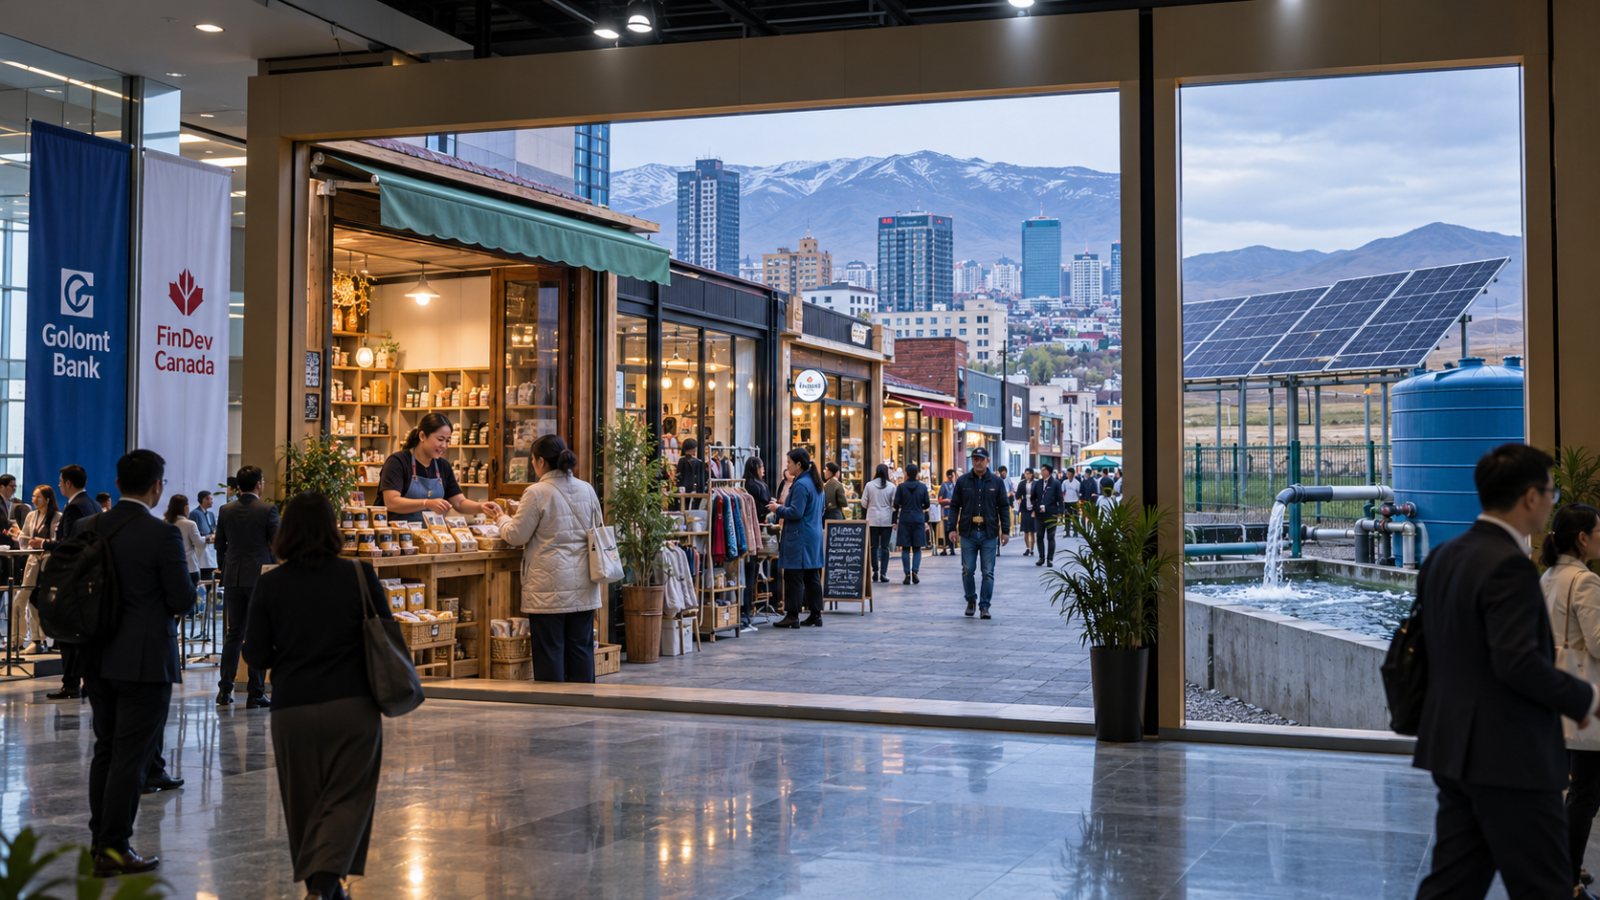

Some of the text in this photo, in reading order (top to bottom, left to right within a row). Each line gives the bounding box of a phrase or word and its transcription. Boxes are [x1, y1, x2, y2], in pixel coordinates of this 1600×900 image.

[42, 323, 110, 352] Golomt
[157, 325, 213, 350] FinDev
[53, 353, 101, 379] Bank
[155, 351, 215, 375] Canada
